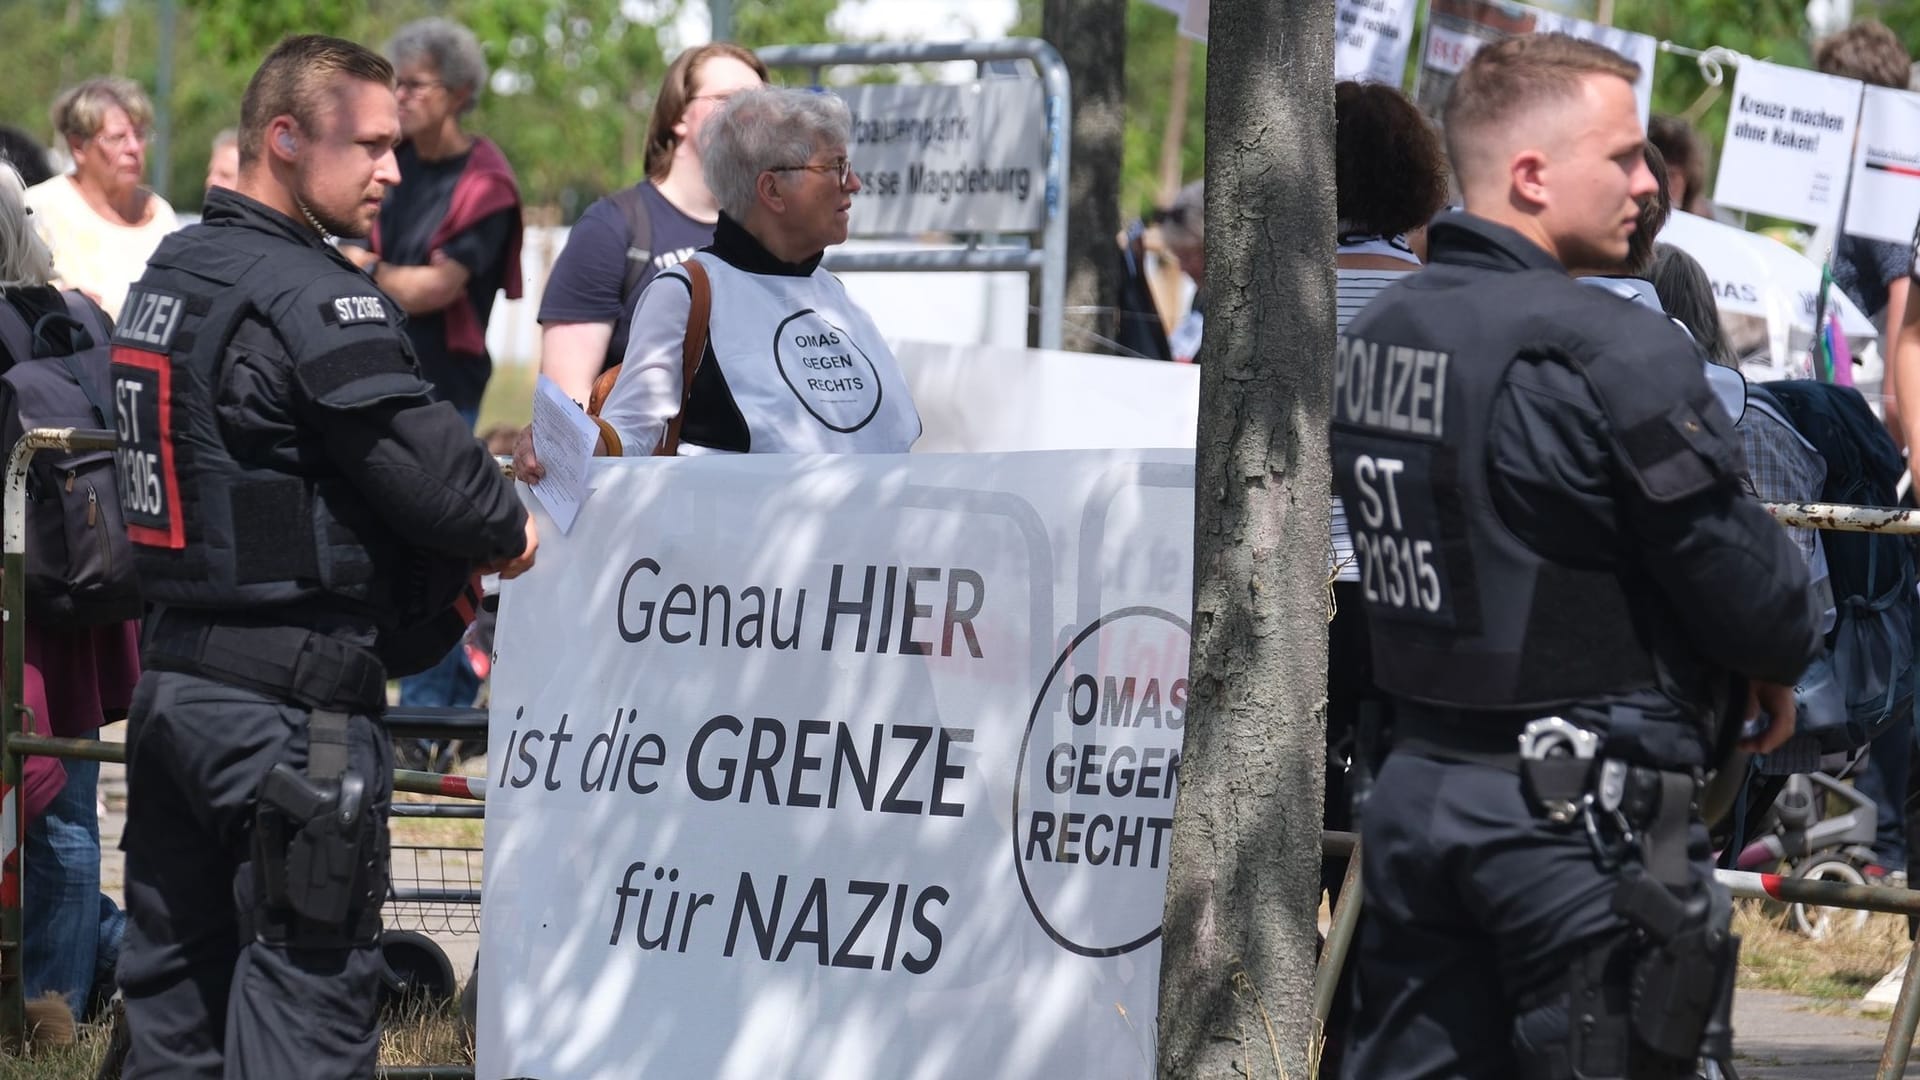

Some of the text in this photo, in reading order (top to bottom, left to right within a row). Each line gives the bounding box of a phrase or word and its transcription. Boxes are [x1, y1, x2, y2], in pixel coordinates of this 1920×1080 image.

[1734, 121, 1767, 142] ohne
[1739, 95, 1844, 132] Kreuze machen
[909, 162, 1031, 202] Magdeburg
[335, 298, 355, 320] ST
[795, 332, 840, 349] OMAS
[803, 354, 853, 370] GEGEN
[116, 379, 143, 443] ST
[807, 377, 864, 392] RECHTS
[1332, 336, 1448, 438] POLIZEI
[1354, 454, 1404, 531] ST
[1356, 531, 1441, 612] 21315
[617, 557, 806, 650] Genau
[821, 564, 985, 659] HIER
[1068, 673, 1187, 730] OMAS
[499, 706, 975, 817] ist die GRENZE
[1025, 810, 1173, 869] RECHT
[609, 862, 950, 975] für NAZIS
